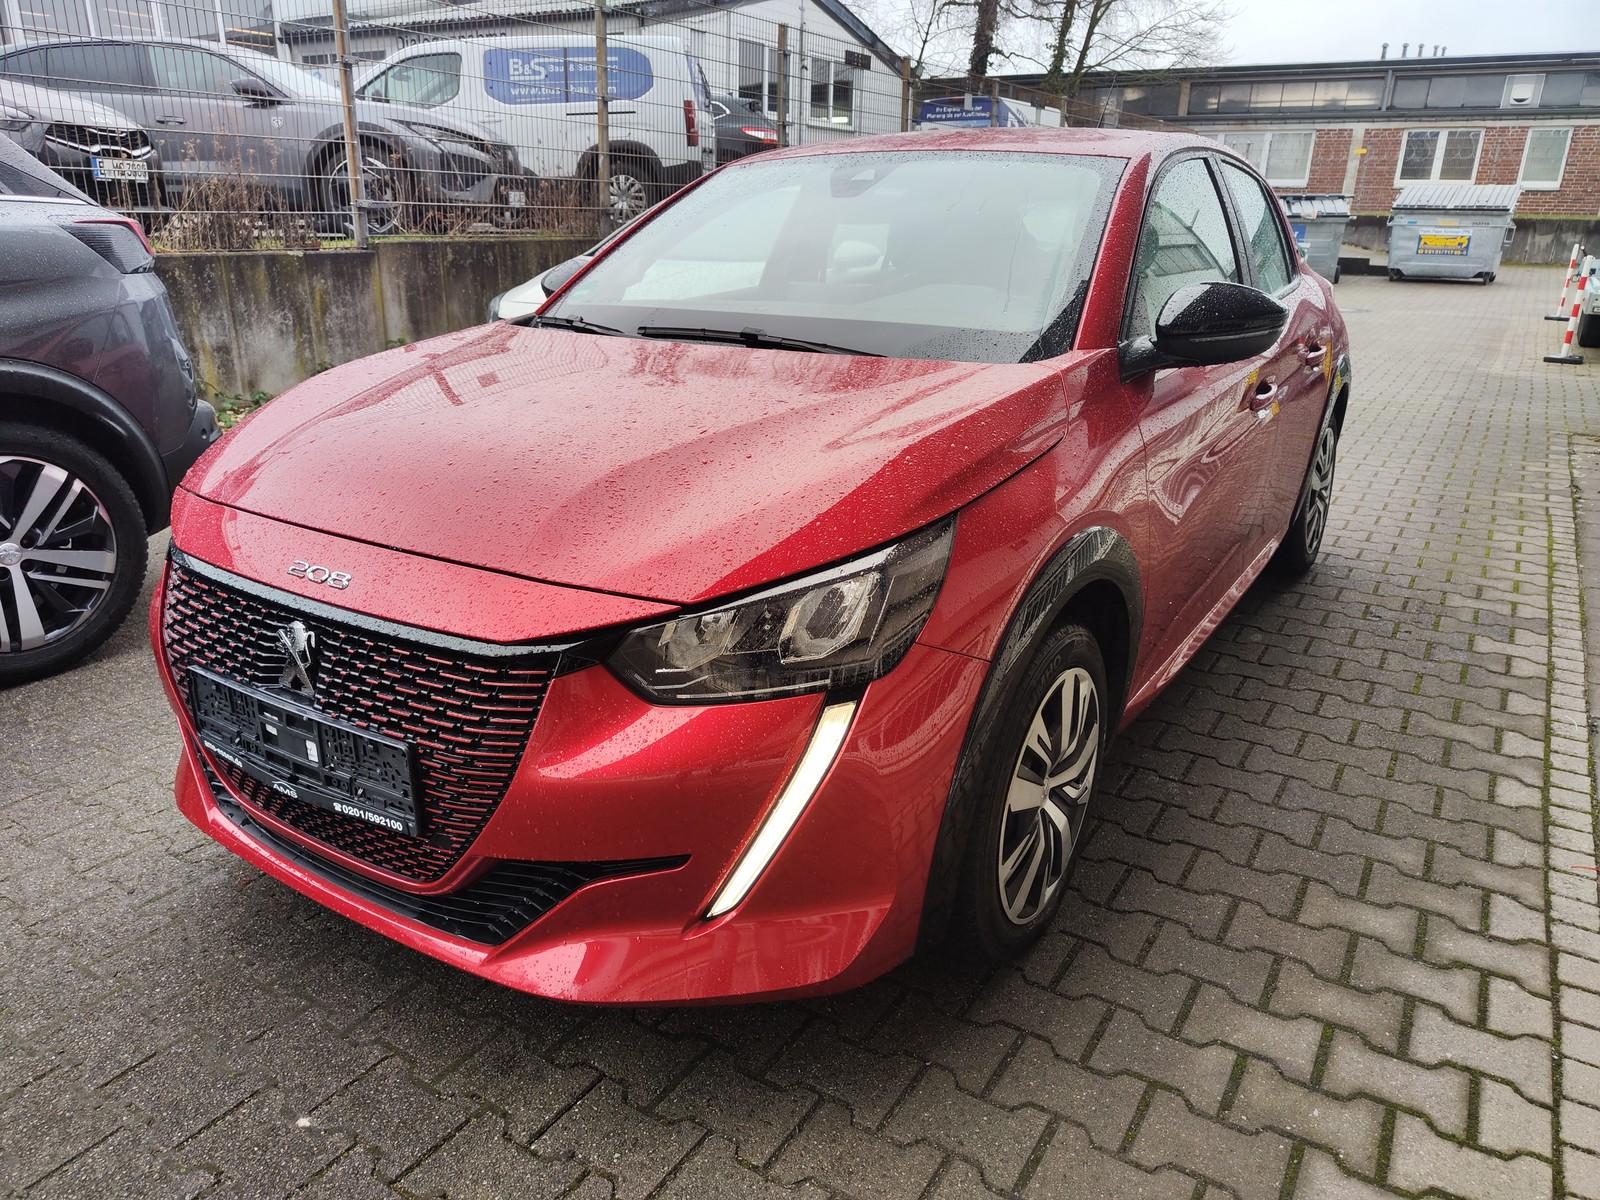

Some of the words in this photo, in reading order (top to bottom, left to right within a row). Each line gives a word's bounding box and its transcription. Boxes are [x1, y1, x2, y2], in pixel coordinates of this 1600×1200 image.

[509, 58, 546, 81] B&S
[287, 560, 352, 590] 208
[273, 783, 298, 798] AMS
[342, 804, 403, 831] 0201/592100
